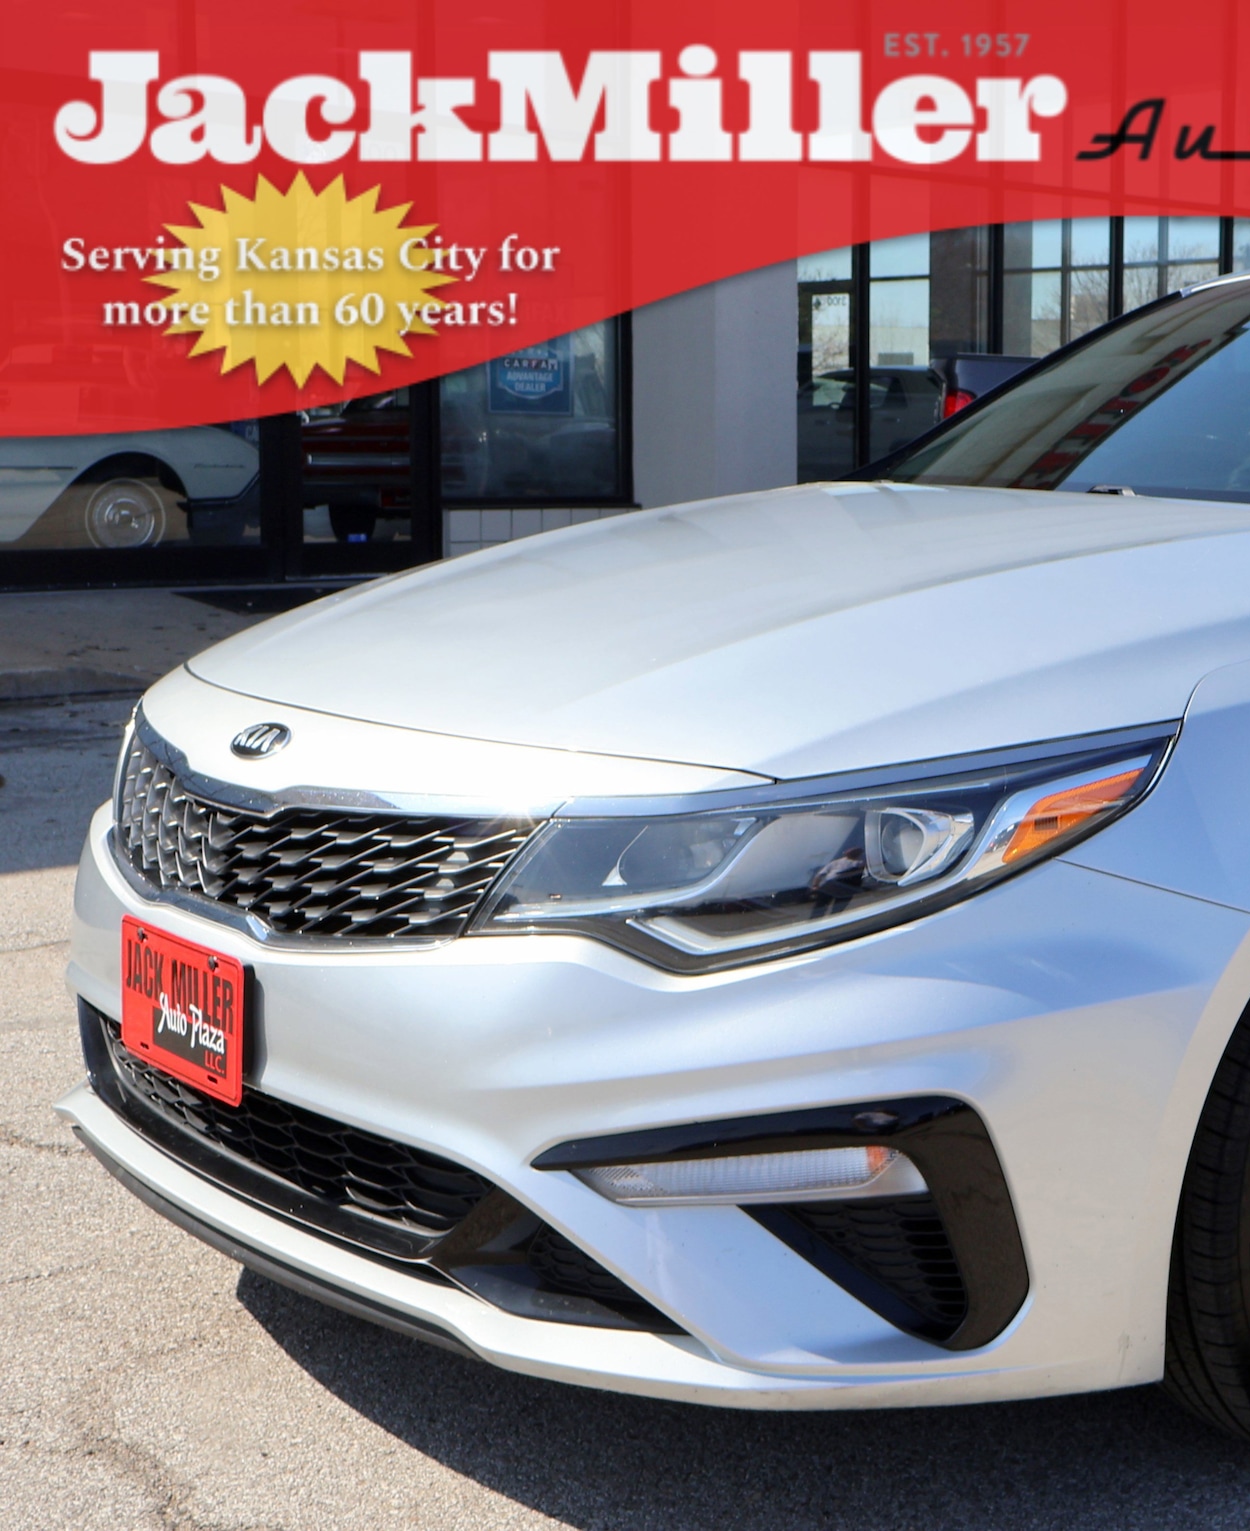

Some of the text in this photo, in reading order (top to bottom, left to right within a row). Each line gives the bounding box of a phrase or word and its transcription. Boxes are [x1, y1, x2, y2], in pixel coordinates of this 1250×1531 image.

[507, 371, 553, 381] ADVANTAGE
[515, 382, 546, 392] DEALER
[234, 725, 280, 752] KIA
[126, 938, 234, 1035] JACK MILLER
[157, 992, 225, 1055] Auto Plaza
